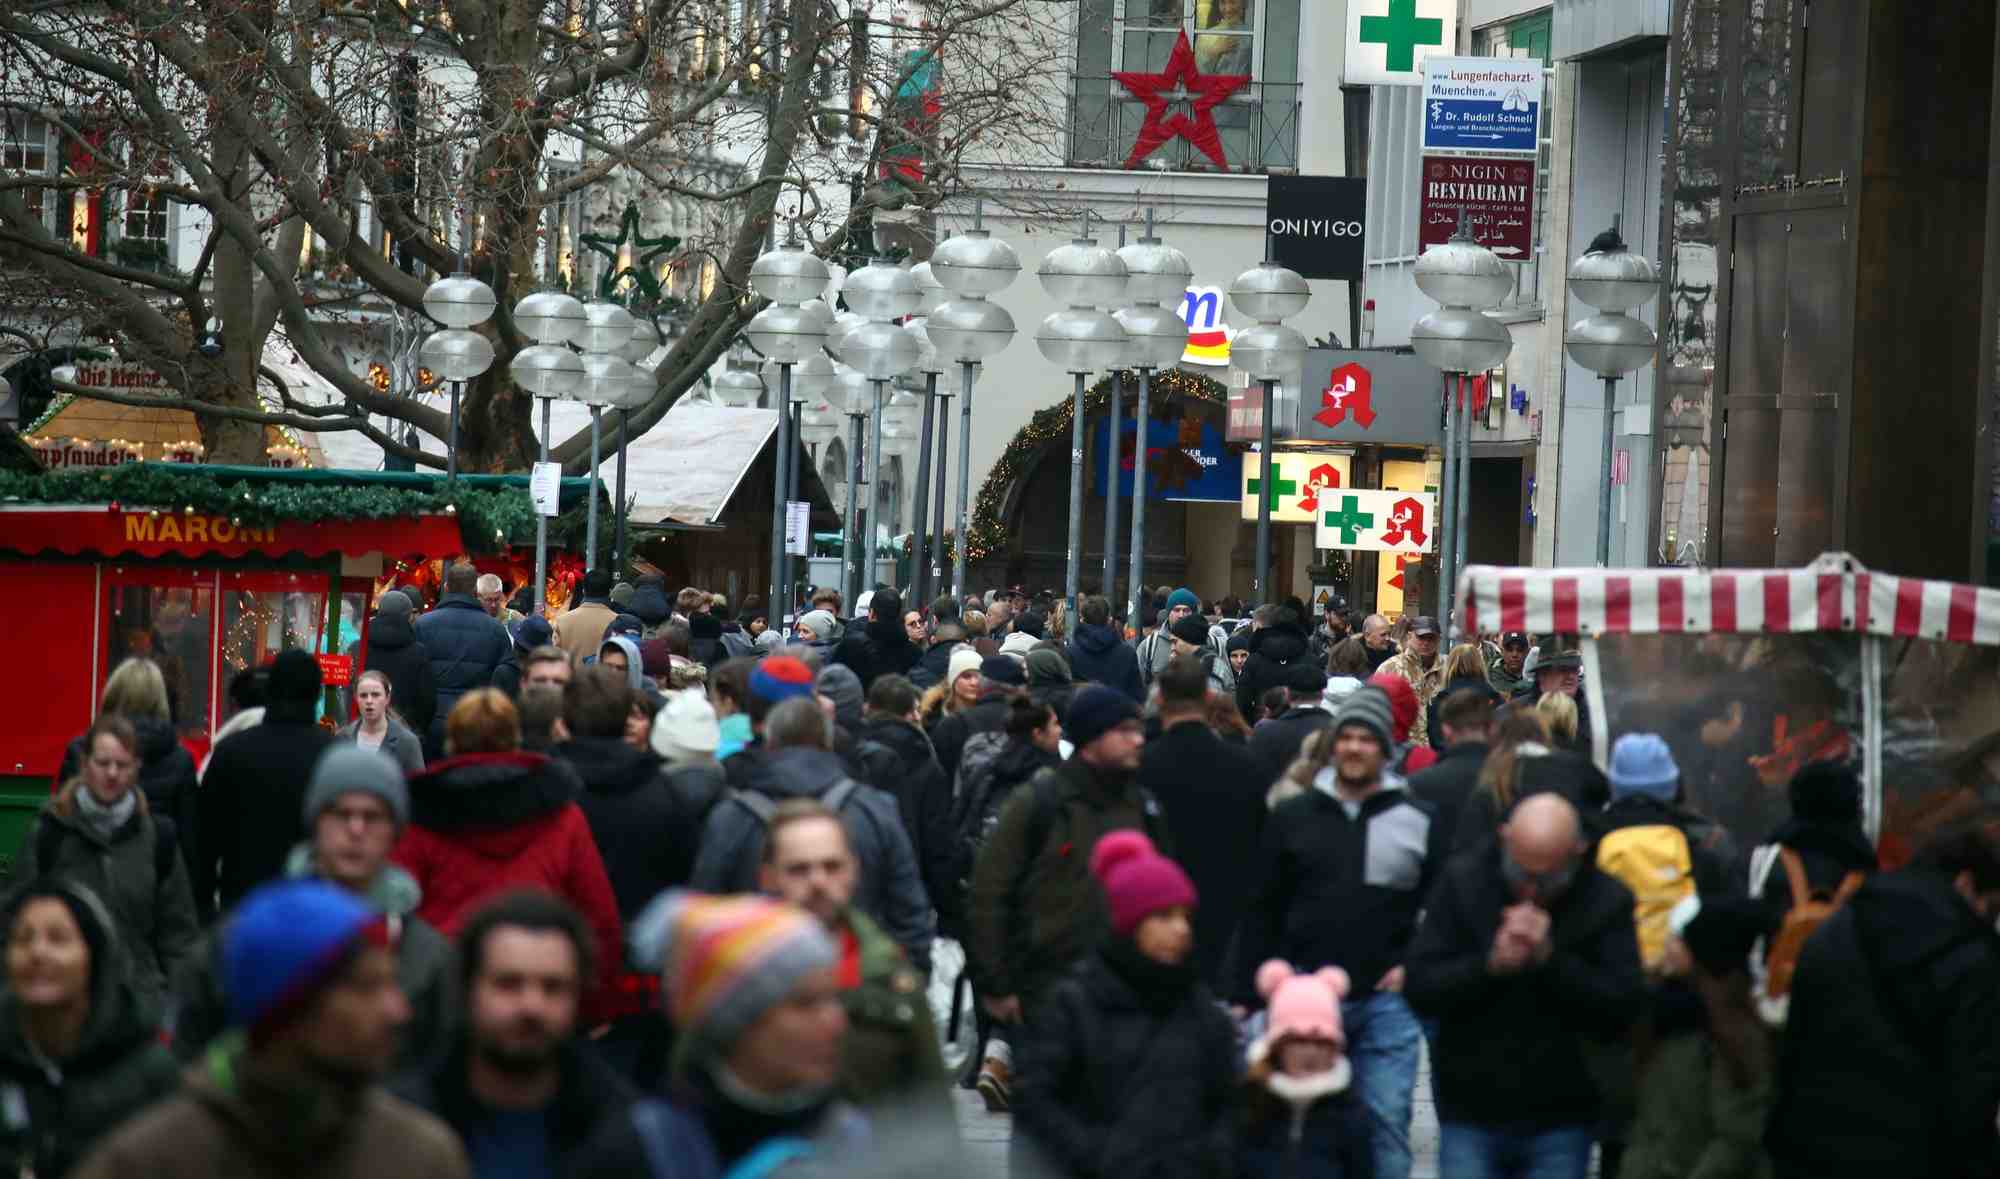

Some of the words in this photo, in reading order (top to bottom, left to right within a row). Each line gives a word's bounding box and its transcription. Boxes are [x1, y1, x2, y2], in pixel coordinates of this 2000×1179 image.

[1432, 84, 1497, 97] Muenchen.de
[1446, 111, 1460, 121] Dr.
[1463, 112, 1495, 123] Rudolf
[1497, 113, 1533, 124] Schnell
[1450, 164, 1507, 180] NIGIN
[1428, 181, 1528, 202] RESTAURANT
